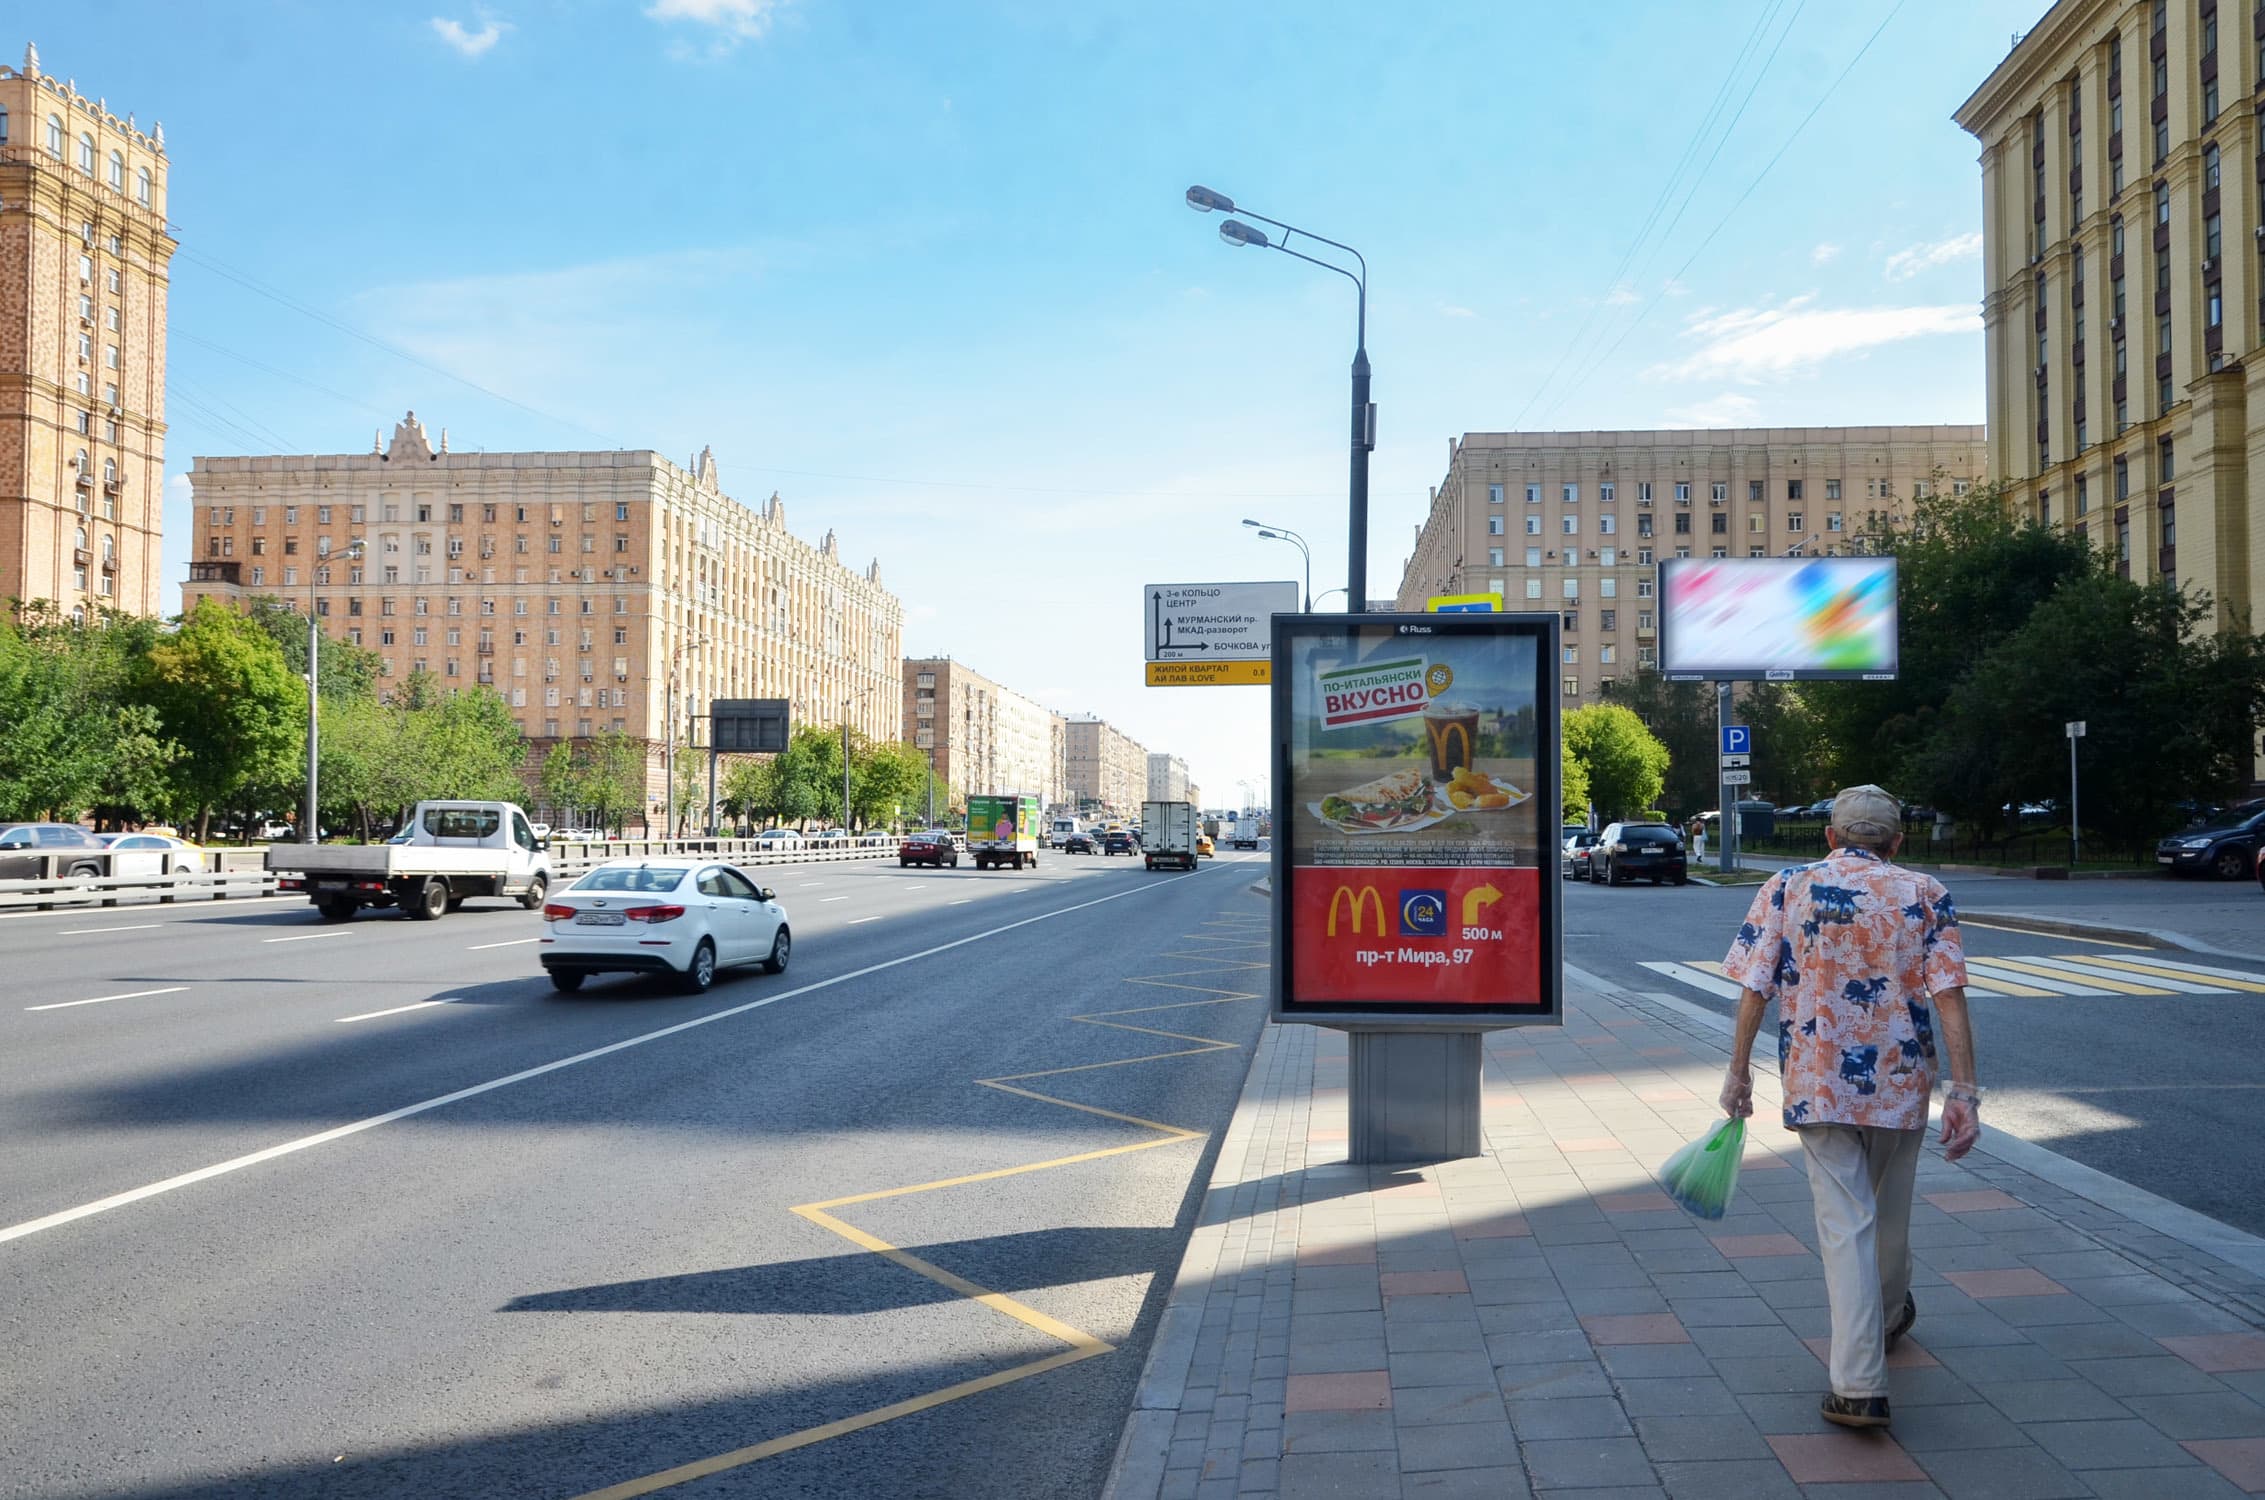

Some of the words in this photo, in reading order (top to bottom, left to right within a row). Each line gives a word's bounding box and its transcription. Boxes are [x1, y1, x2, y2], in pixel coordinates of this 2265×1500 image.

[1182, 588, 1221, 598] КОЛЬЦО
[1166, 600, 1197, 608] ЦЕНТР
[1177, 614, 1242, 624] МУРМАНСКИЙ
[1177, 627, 1248, 635] МКАД-разворот
[1409, 625, 1432, 633] Russ
[1214, 642, 1259, 651] БОЧКОВА
[1154, 664, 1187, 673] ЖИЛОЙ
[1189, 664, 1229, 673] КВАРТАЛ
[1323, 669, 1421, 693] ПО-ИТАЛЬЯНСКИ
[1325, 682, 1424, 713] ВКУСНО
[1730, 729, 1745, 750] P
[1418, 905, 1434, 917] 24
[1462, 927, 1489, 940] 500
[1491, 930, 1503, 940] м
[1356, 950, 1394, 966] пр-т
[1398, 948, 1450, 967] Мира,
[1452, 949, 1474, 964] 97
